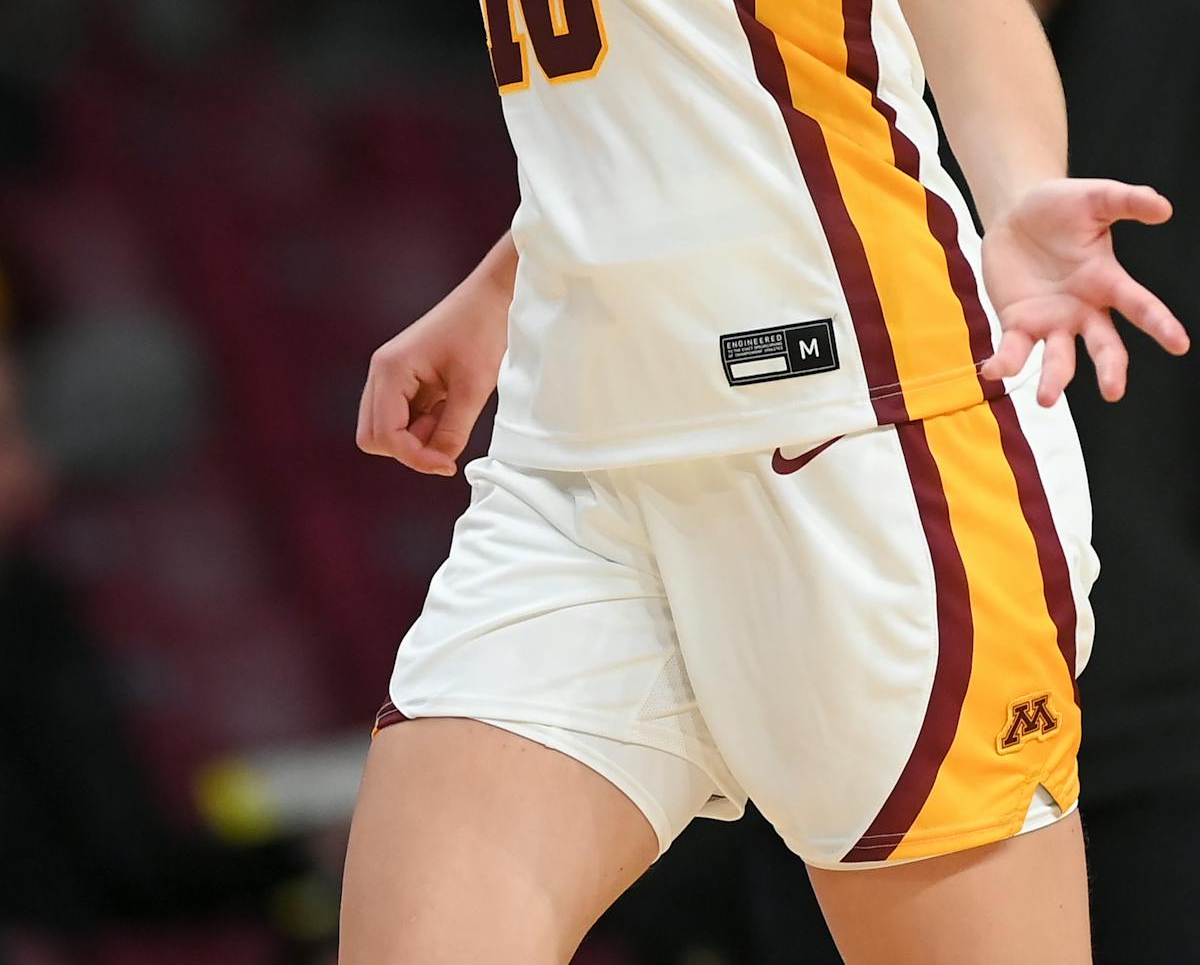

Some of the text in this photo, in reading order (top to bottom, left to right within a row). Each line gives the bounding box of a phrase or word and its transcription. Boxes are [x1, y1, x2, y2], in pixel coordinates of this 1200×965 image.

[726, 334, 782, 349] ENGINEERED
[799, 338, 820, 360] M
[1000, 693, 1058, 750] M
